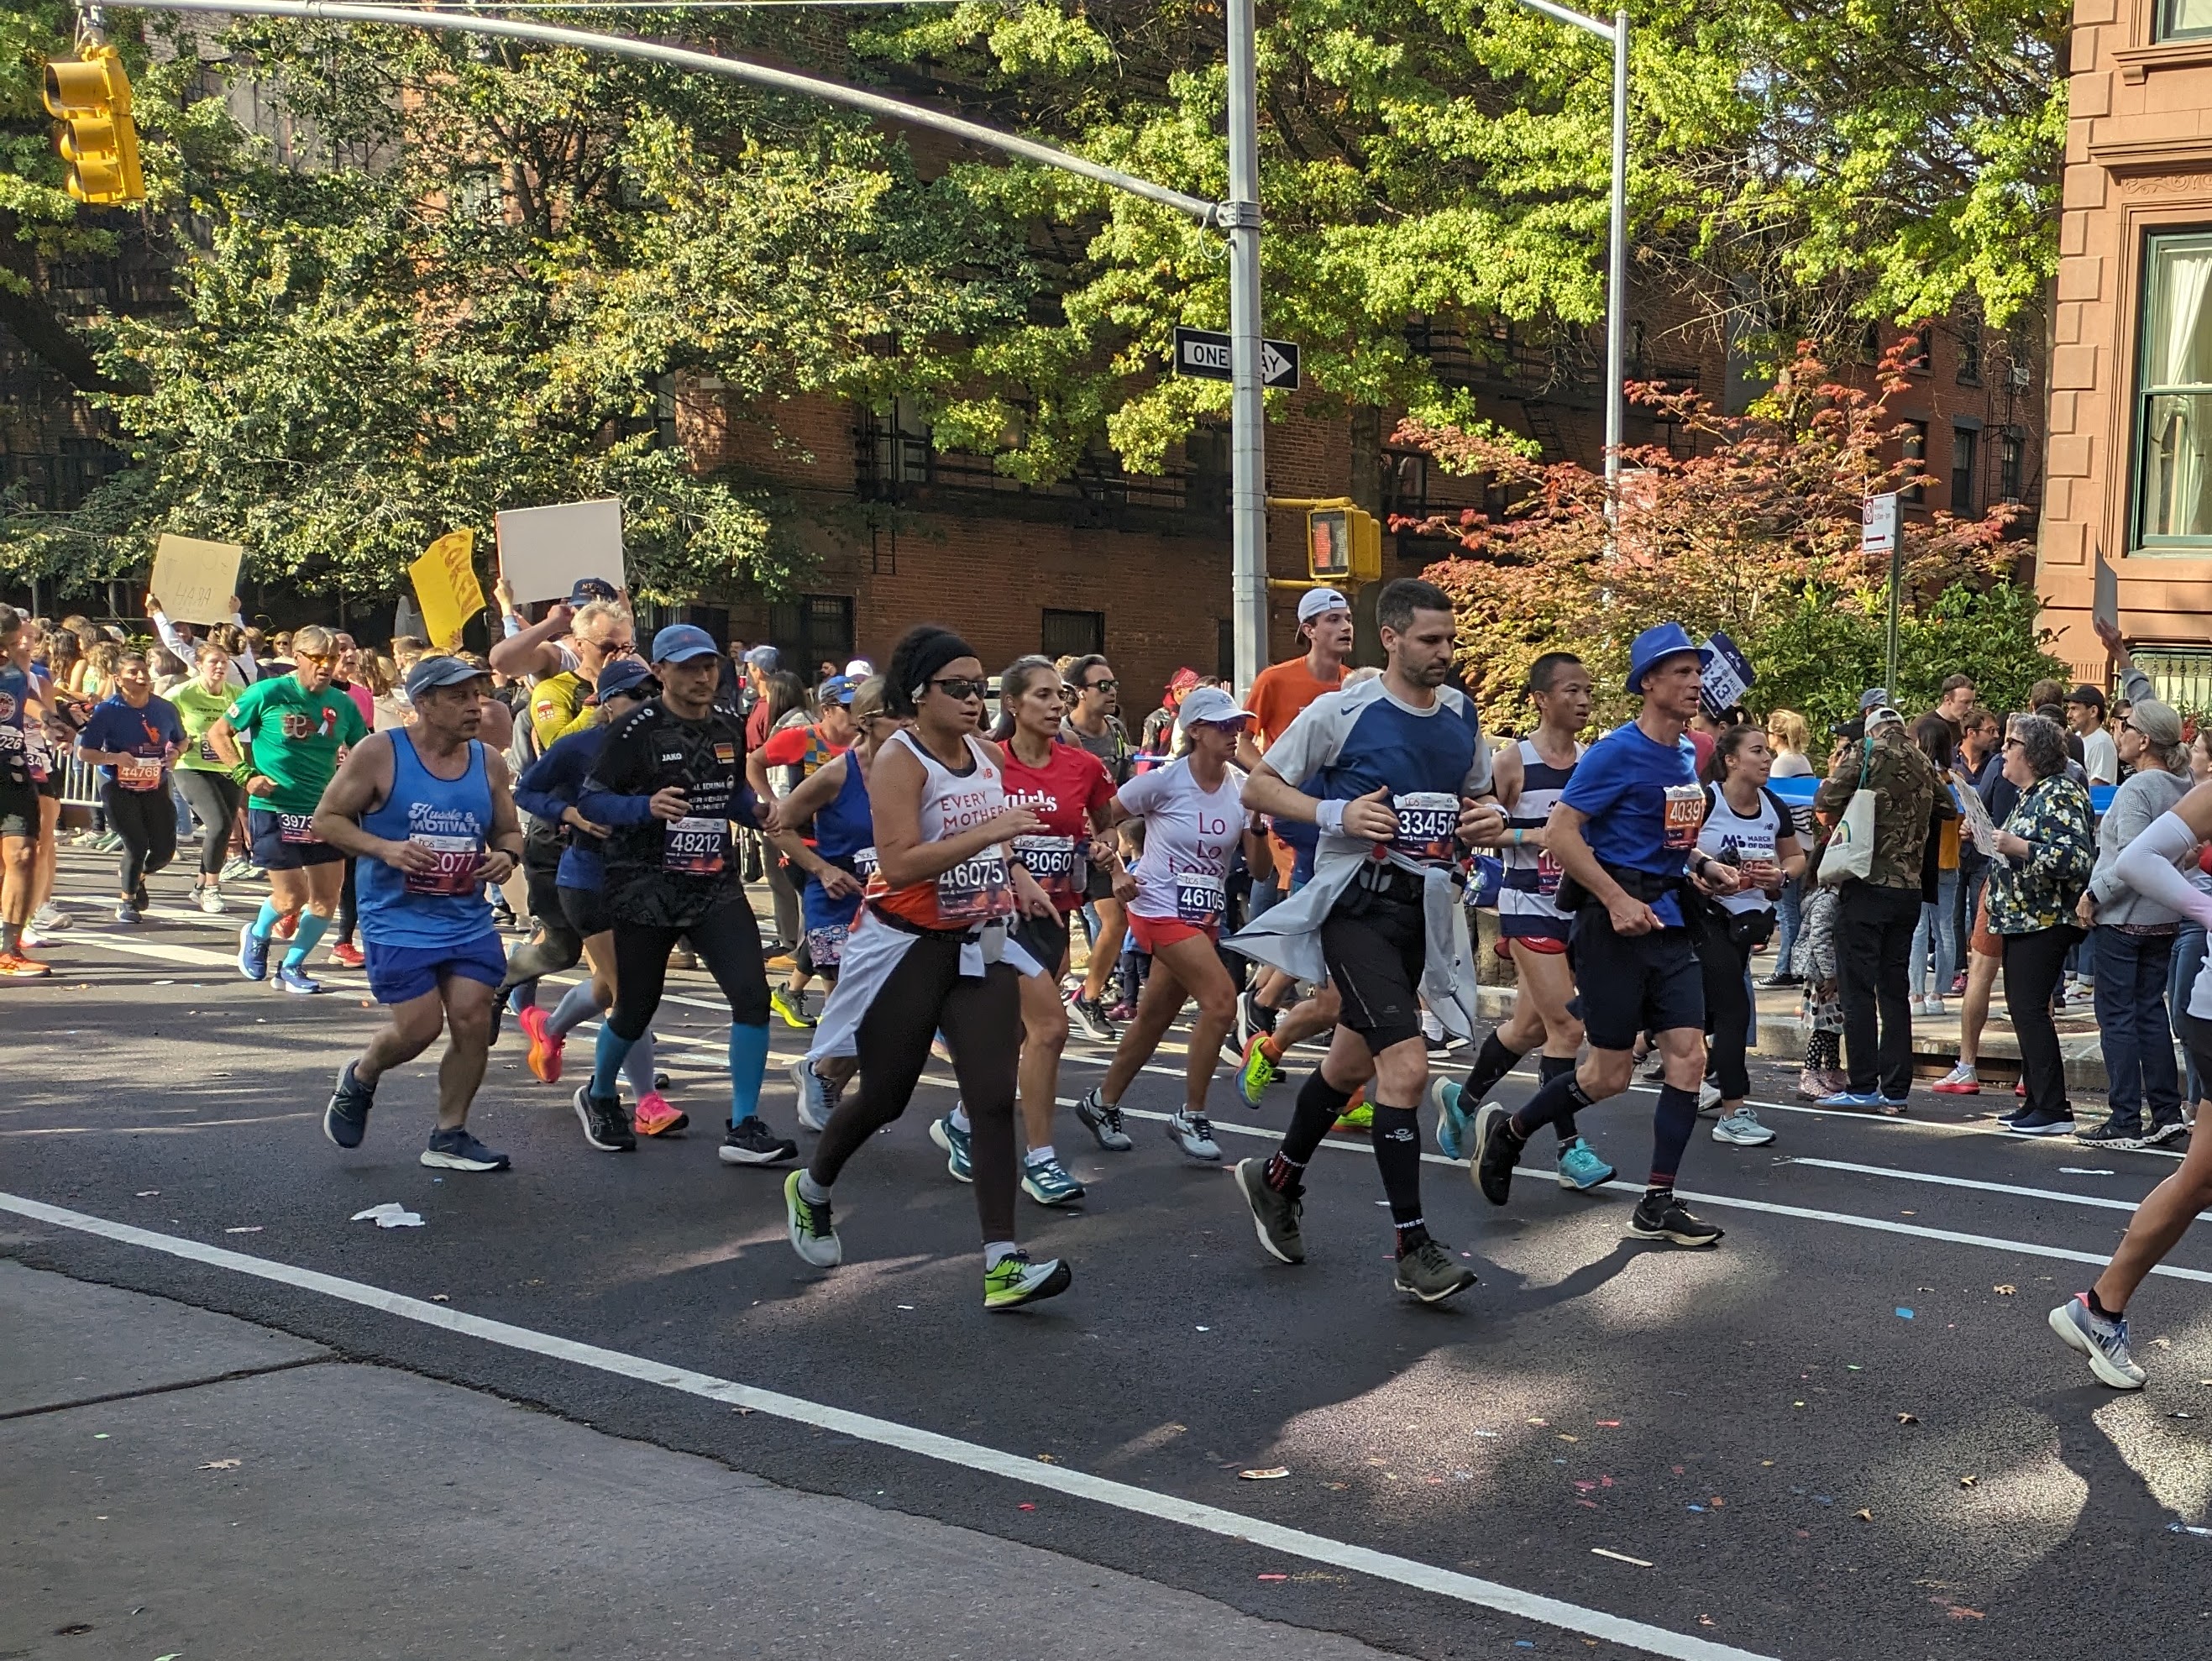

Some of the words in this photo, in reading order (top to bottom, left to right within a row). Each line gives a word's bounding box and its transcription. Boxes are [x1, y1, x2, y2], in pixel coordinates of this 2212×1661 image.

[1193, 345, 1228, 366] ONE
[1262, 354, 1280, 373] AY
[1727, 678, 1741, 694] MILE
[662, 752, 683, 762] JAKO
[941, 791, 987, 811] EVERY
[464, 811, 475, 823] &
[1398, 811, 1456, 836] 33456
[410, 820, 481, 834] MOTIVATE
[671, 833, 721, 851] 48212
[939, 860, 1004, 888] 46075
[1181, 888, 1225, 910] 46105
